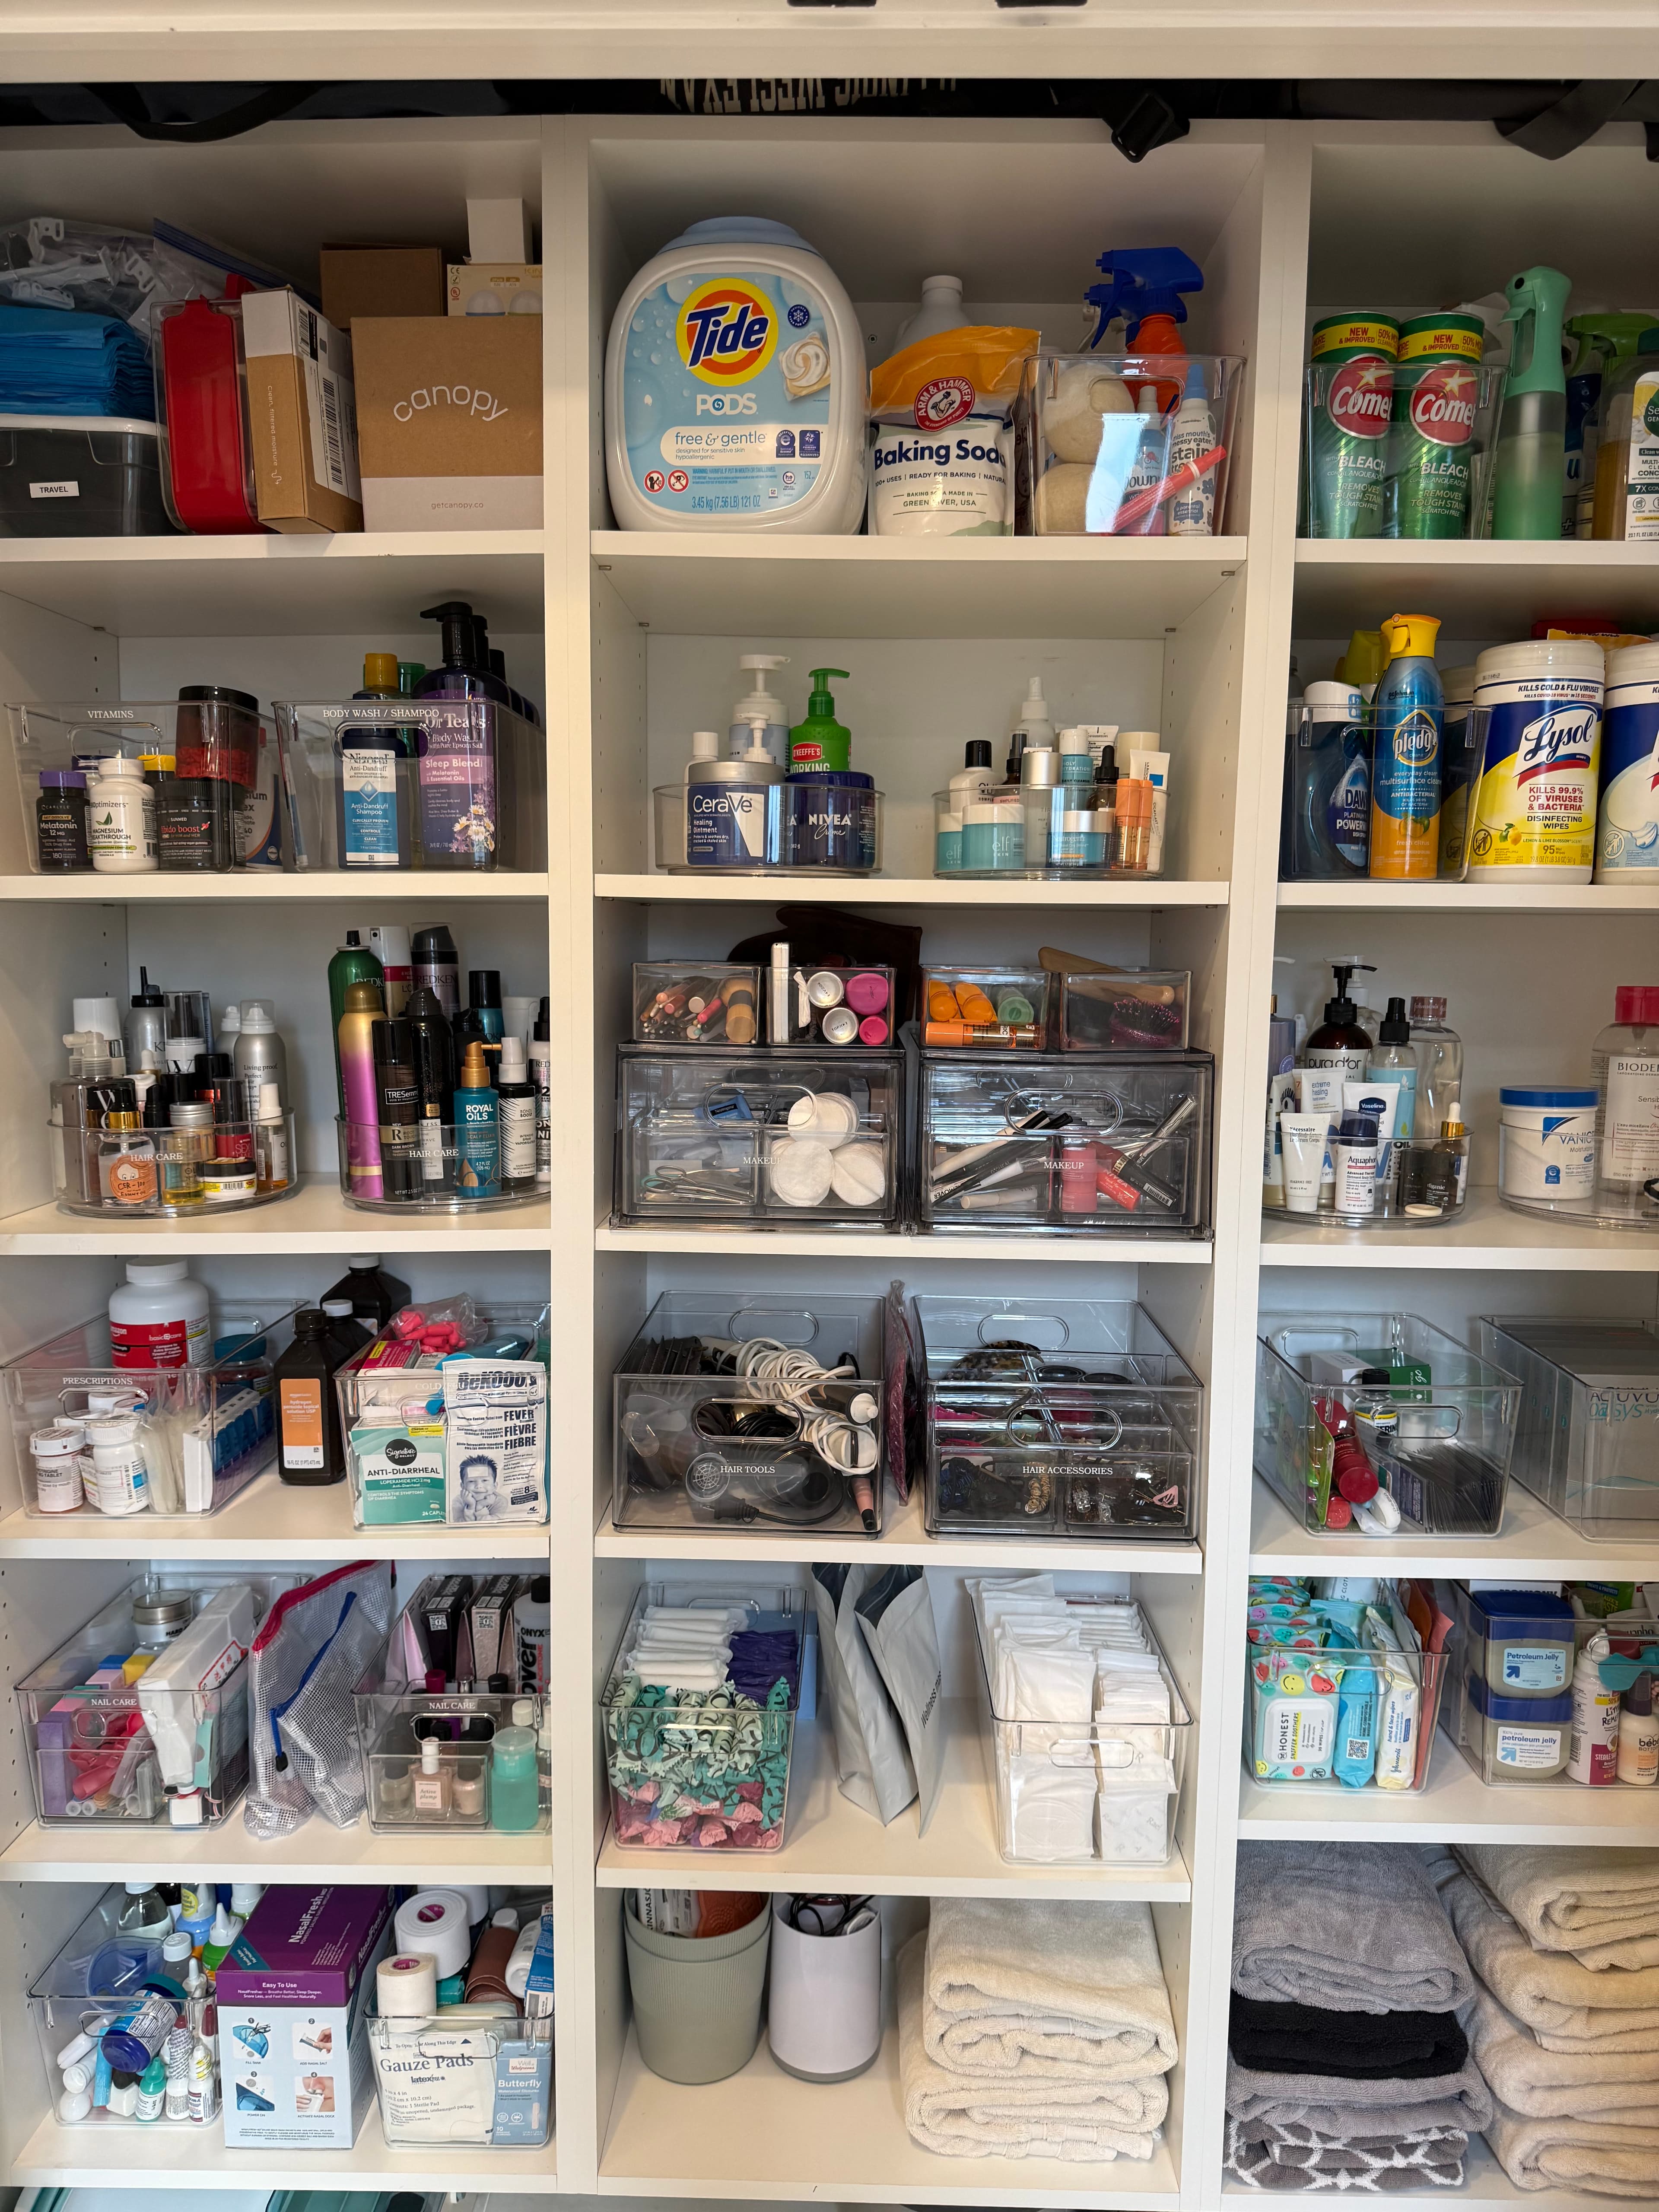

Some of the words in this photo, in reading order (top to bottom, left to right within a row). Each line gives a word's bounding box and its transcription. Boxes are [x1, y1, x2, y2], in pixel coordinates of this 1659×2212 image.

[686, 303, 770, 370] Tide
[1350, 328, 1369, 336] NEW
[1378, 329, 1390, 338] 50%
[1433, 334, 1452, 343] NEW
[1462, 336, 1474, 346] 50%
[918, 391, 930, 416] ARM
[929, 386, 938, 394] &
[939, 379, 971, 401] HAMMER
[393, 384, 508, 422] canopy
[696, 393, 757, 416] PODS
[675, 432, 702, 445] free
[706, 433, 719, 445] &
[721, 431, 766, 447] gentle
[1172, 439, 1192, 447] messy
[874, 440, 950, 470] Baking
[1340, 456, 1386, 473] BLEACH
[1341, 483, 1379, 493] REMOVES
[1424, 490, 1462, 500] REMOVES
[431, 501, 483, 509] getcanopy.co
[88, 710, 133, 718] VITAMINS
[323, 709, 350, 718] BODY
[1524, 714, 1593, 763] Lysol
[792, 747, 821, 758] O'KEEFFE'S
[426, 759, 449, 769] Sleep
[453, 759, 480, 767] Blend
[693, 795, 752, 813] CeraVe
[809, 814, 851, 826] NIVEA
[992, 836, 1011, 853] elf
[1543, 845, 1555, 854] 95
[417, 975, 456, 985] REDKEN
[1335, 1057, 1362, 1070] d'or
[466, 1104, 493, 1112] ROYAL
[130, 1154, 154, 1162] HAIR
[409, 1149, 432, 1157] HAIR
[434, 1149, 458, 1157] CARE
[1103, 1169, 1128, 1188] NIVEA
[504, 1410, 534, 1421] FEVER
[505, 1423, 536, 1437] FIÈVRE
[505, 1437, 536, 1450] FIEBRE
[368, 1467, 440, 1476] ANTI-DIARRHEAL
[1047, 1467, 1113, 1475] ACCESSORIES
[521, 1628, 544, 1637] ONYX
[921, 1688, 937, 1729] Wellness
[1279, 1712, 1290, 1751] HONEST
[1541, 1736, 1557, 1745] jelly
[288, 1895, 323, 1943] NasalFresh
[380, 2058, 431, 2072] Gauze
[436, 2053, 474, 2069] Pads
[498, 2079, 541, 2089] Butterfly
